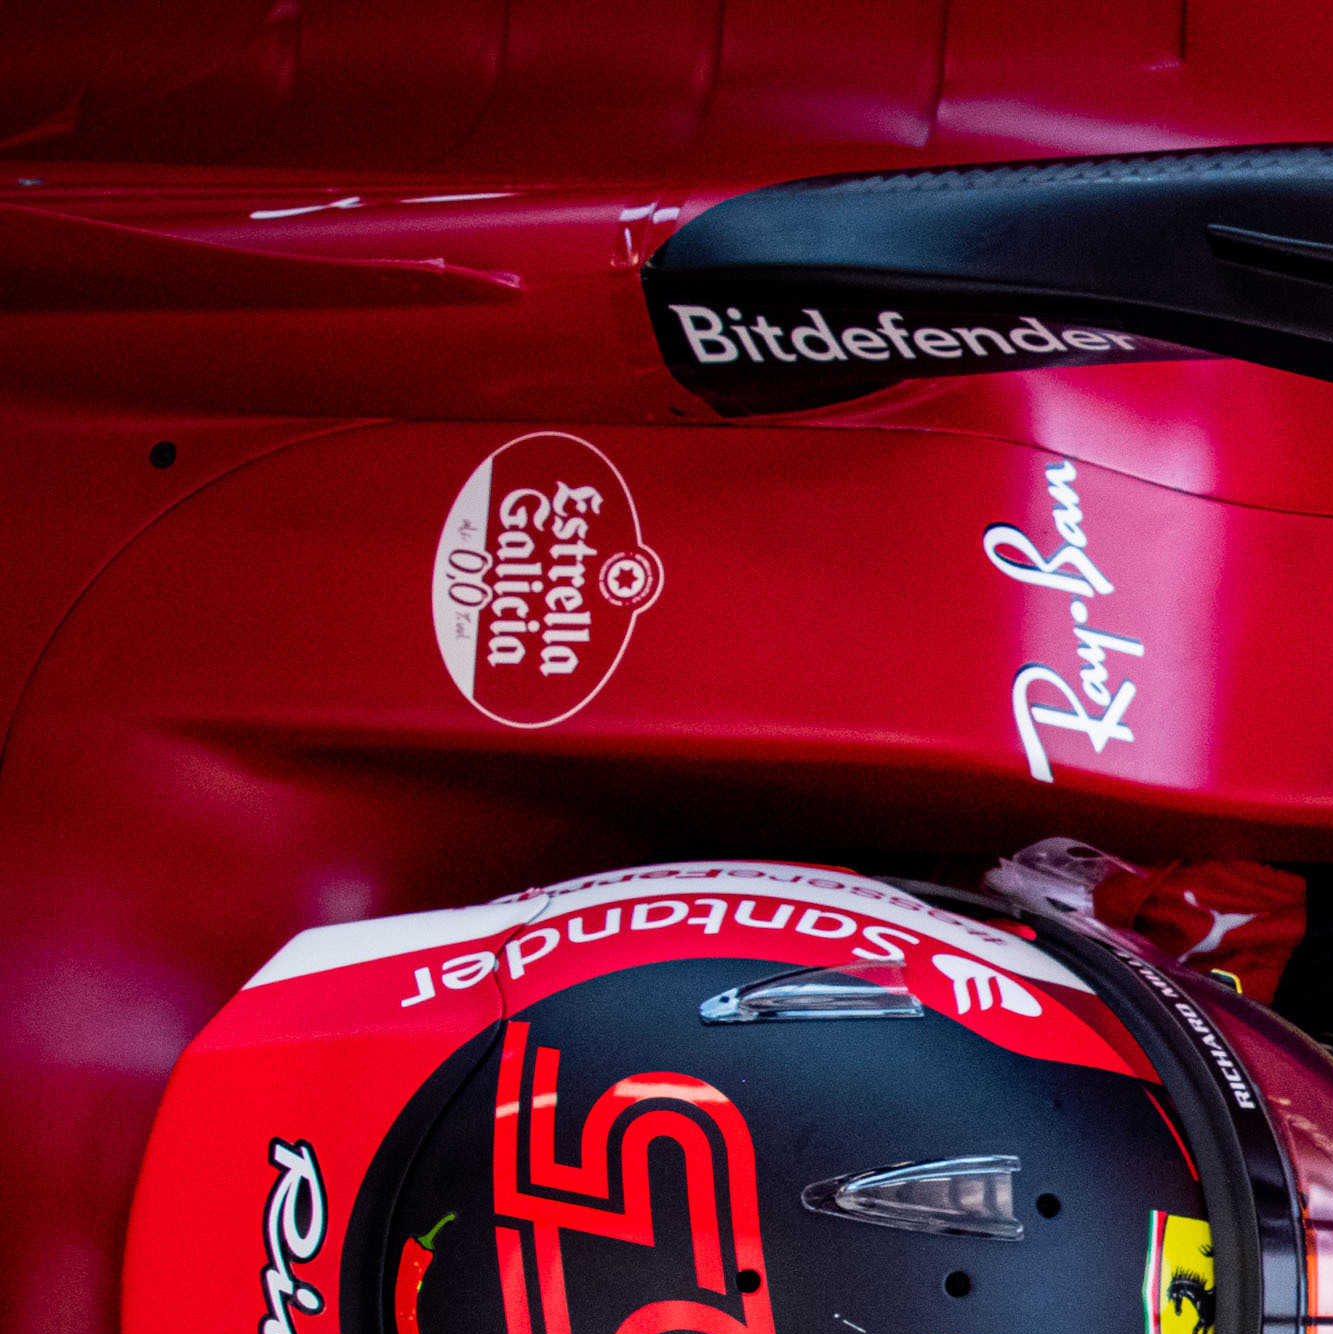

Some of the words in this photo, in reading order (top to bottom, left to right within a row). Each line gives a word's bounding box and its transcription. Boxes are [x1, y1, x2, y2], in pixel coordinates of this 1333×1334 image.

[669, 304, 1135, 363] Bitdefender
[487, 487, 550, 667] Galicia
[539, 480, 604, 677] Estrella
[400, 898, 921, 1008] Santander
[1175, 1002, 1256, 1110] RICHARD
